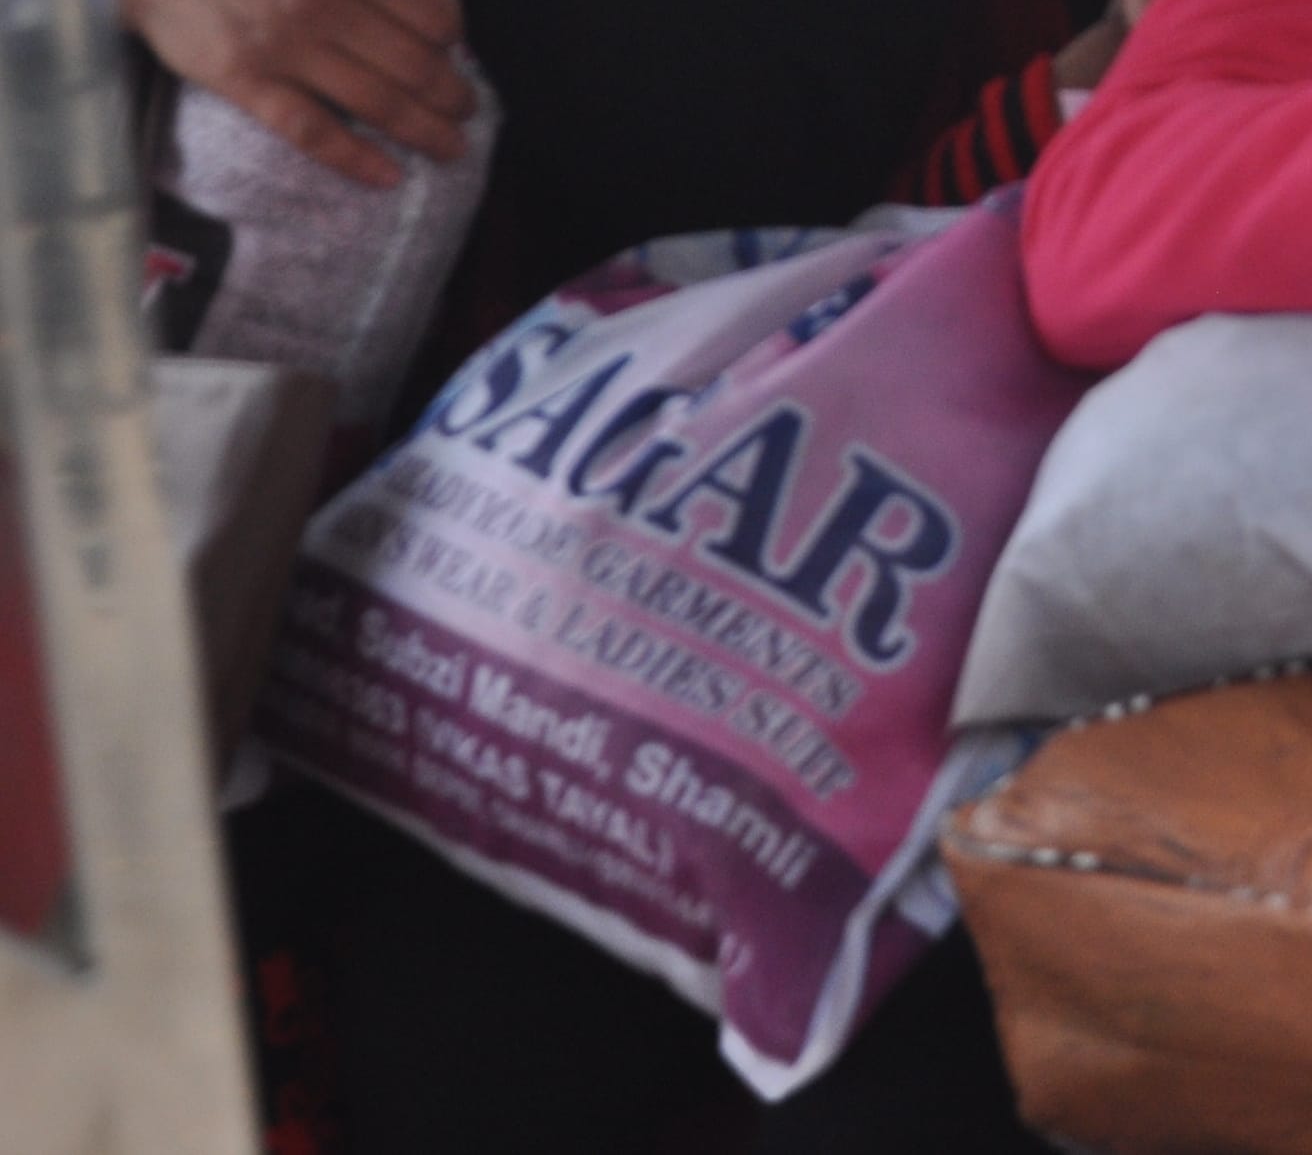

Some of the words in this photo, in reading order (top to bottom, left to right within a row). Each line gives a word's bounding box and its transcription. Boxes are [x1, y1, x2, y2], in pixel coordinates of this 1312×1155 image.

[425, 318, 958, 671] SAGAR
[552, 601, 747, 719] LADIES
[576, 536, 863, 719] GARMENTS
[625, 740, 818, 890] Shamli
